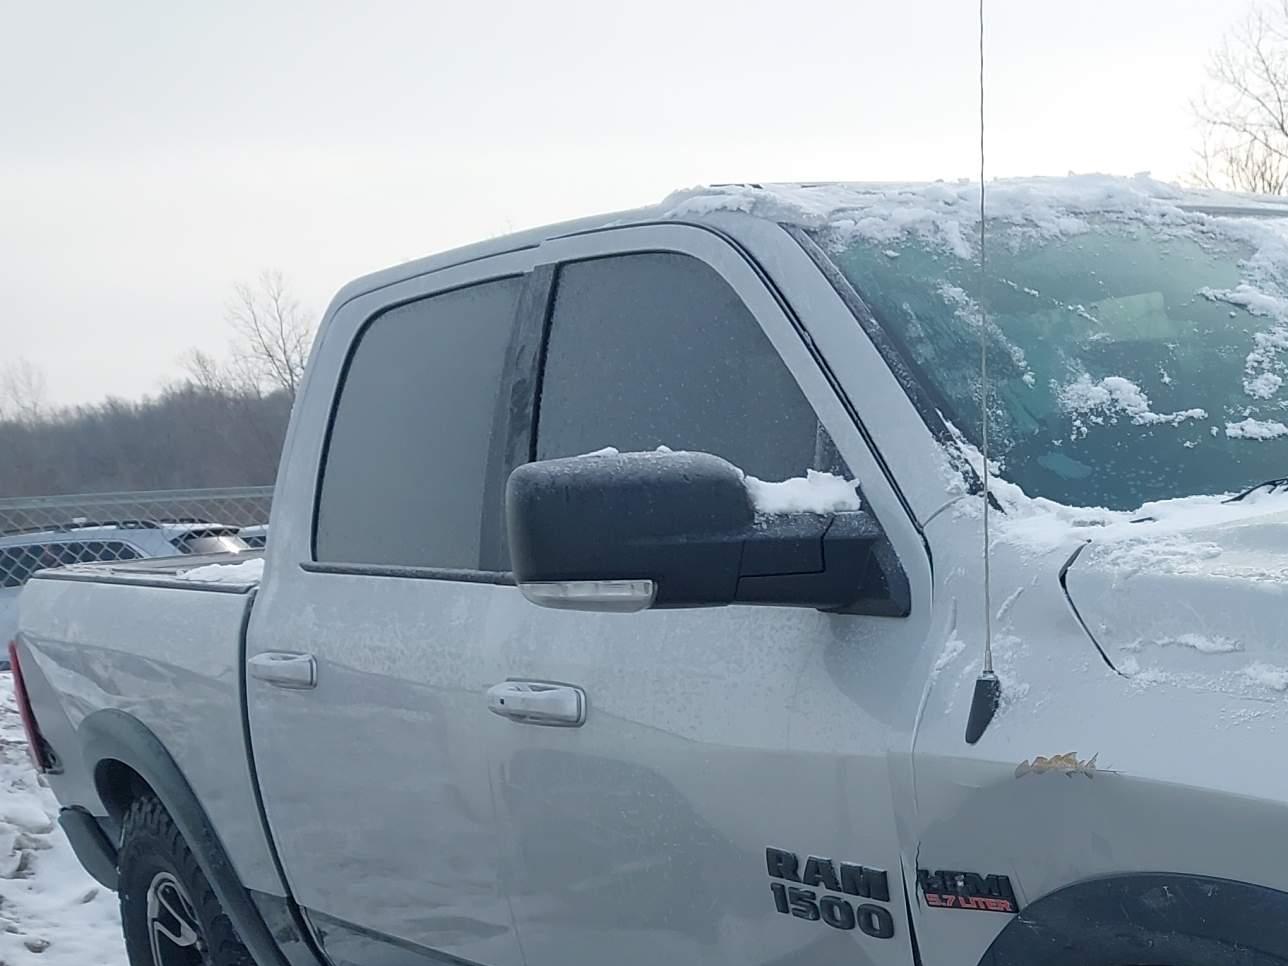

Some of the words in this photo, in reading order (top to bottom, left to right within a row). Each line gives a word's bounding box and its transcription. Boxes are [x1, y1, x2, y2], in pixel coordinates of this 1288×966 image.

[766, 846, 890, 902] RAM
[770, 882, 894, 939] 1500
[958, 895, 1013, 912] LITER
